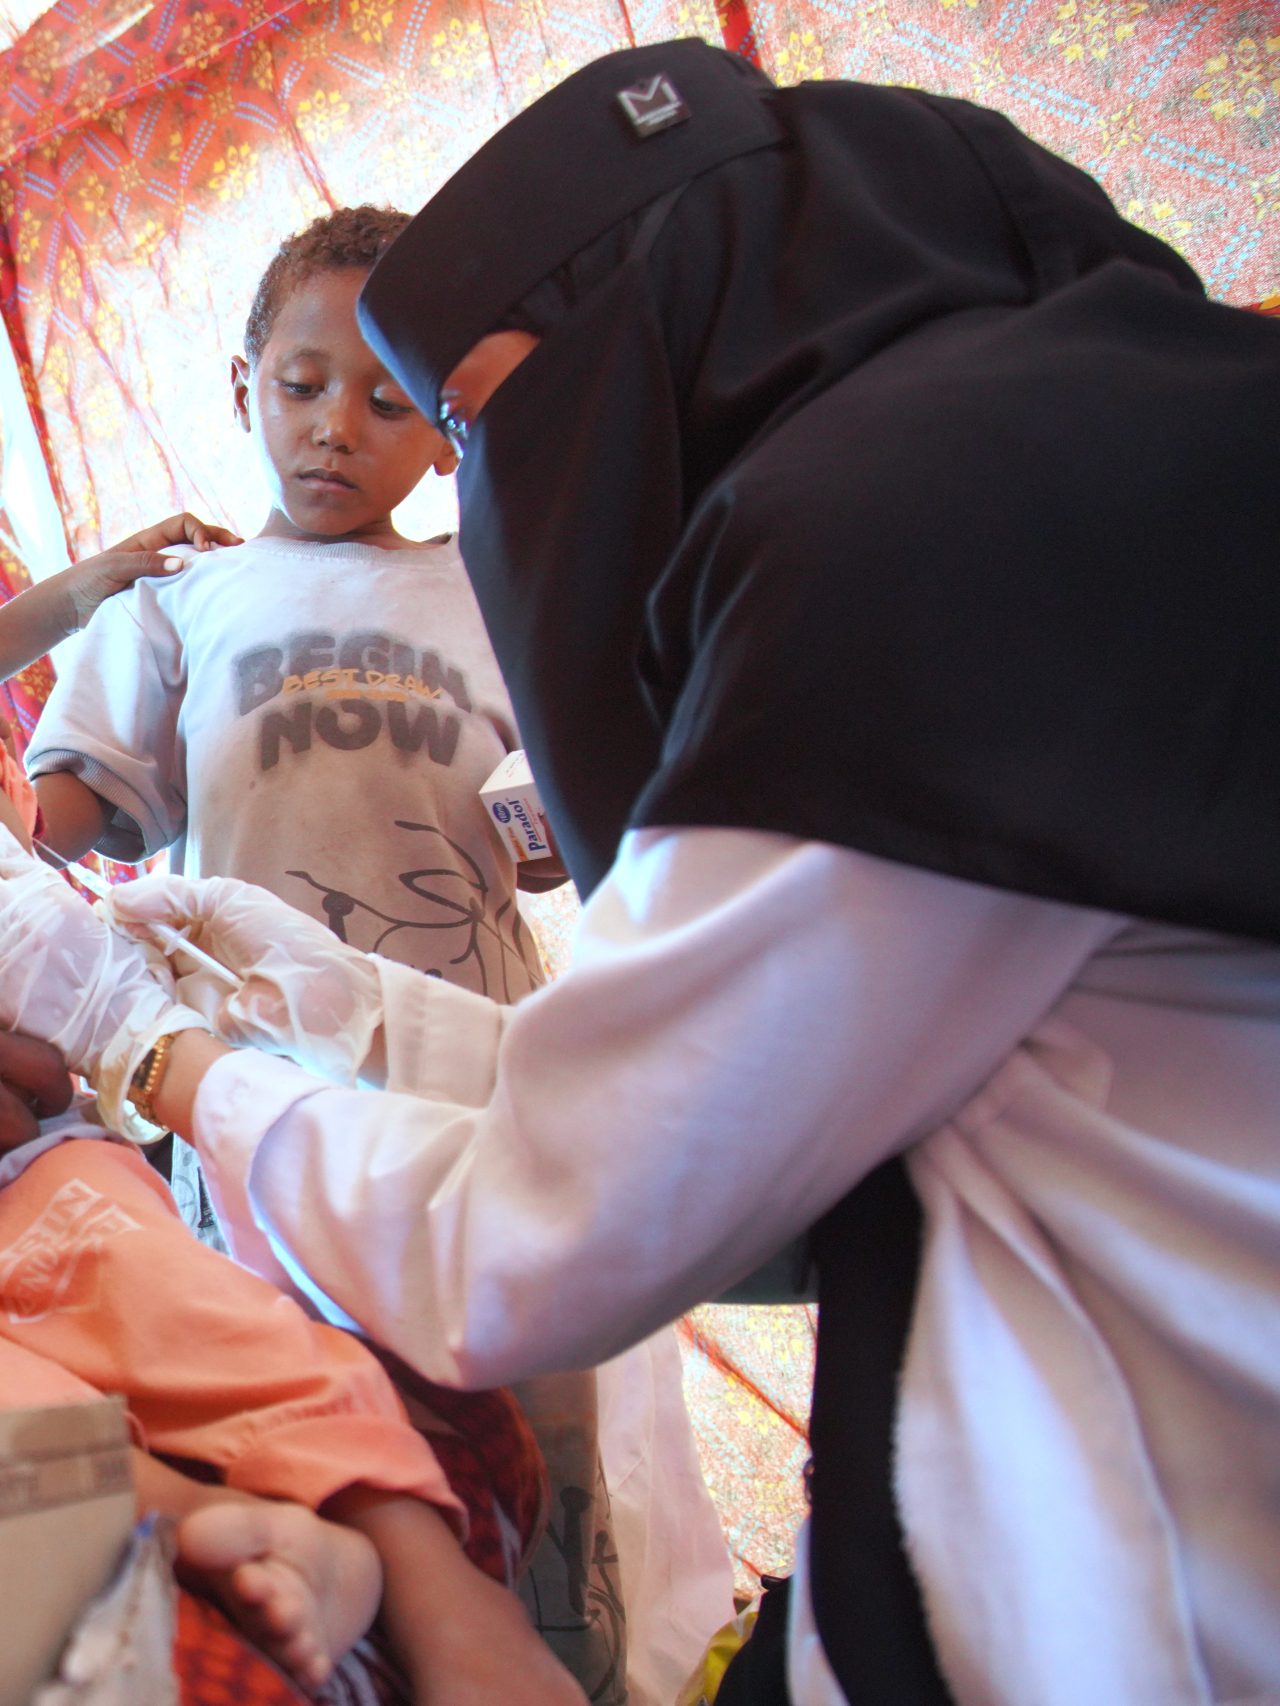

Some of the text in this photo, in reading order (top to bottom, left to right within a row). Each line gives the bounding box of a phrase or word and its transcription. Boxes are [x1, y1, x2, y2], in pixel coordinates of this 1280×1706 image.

[235, 632, 473, 716] BEGIN
[283, 668, 359, 695] BEST
[365, 669, 444, 699] DRAW
[258, 699, 461, 771] NOW
[508, 799, 547, 852] Paradol
